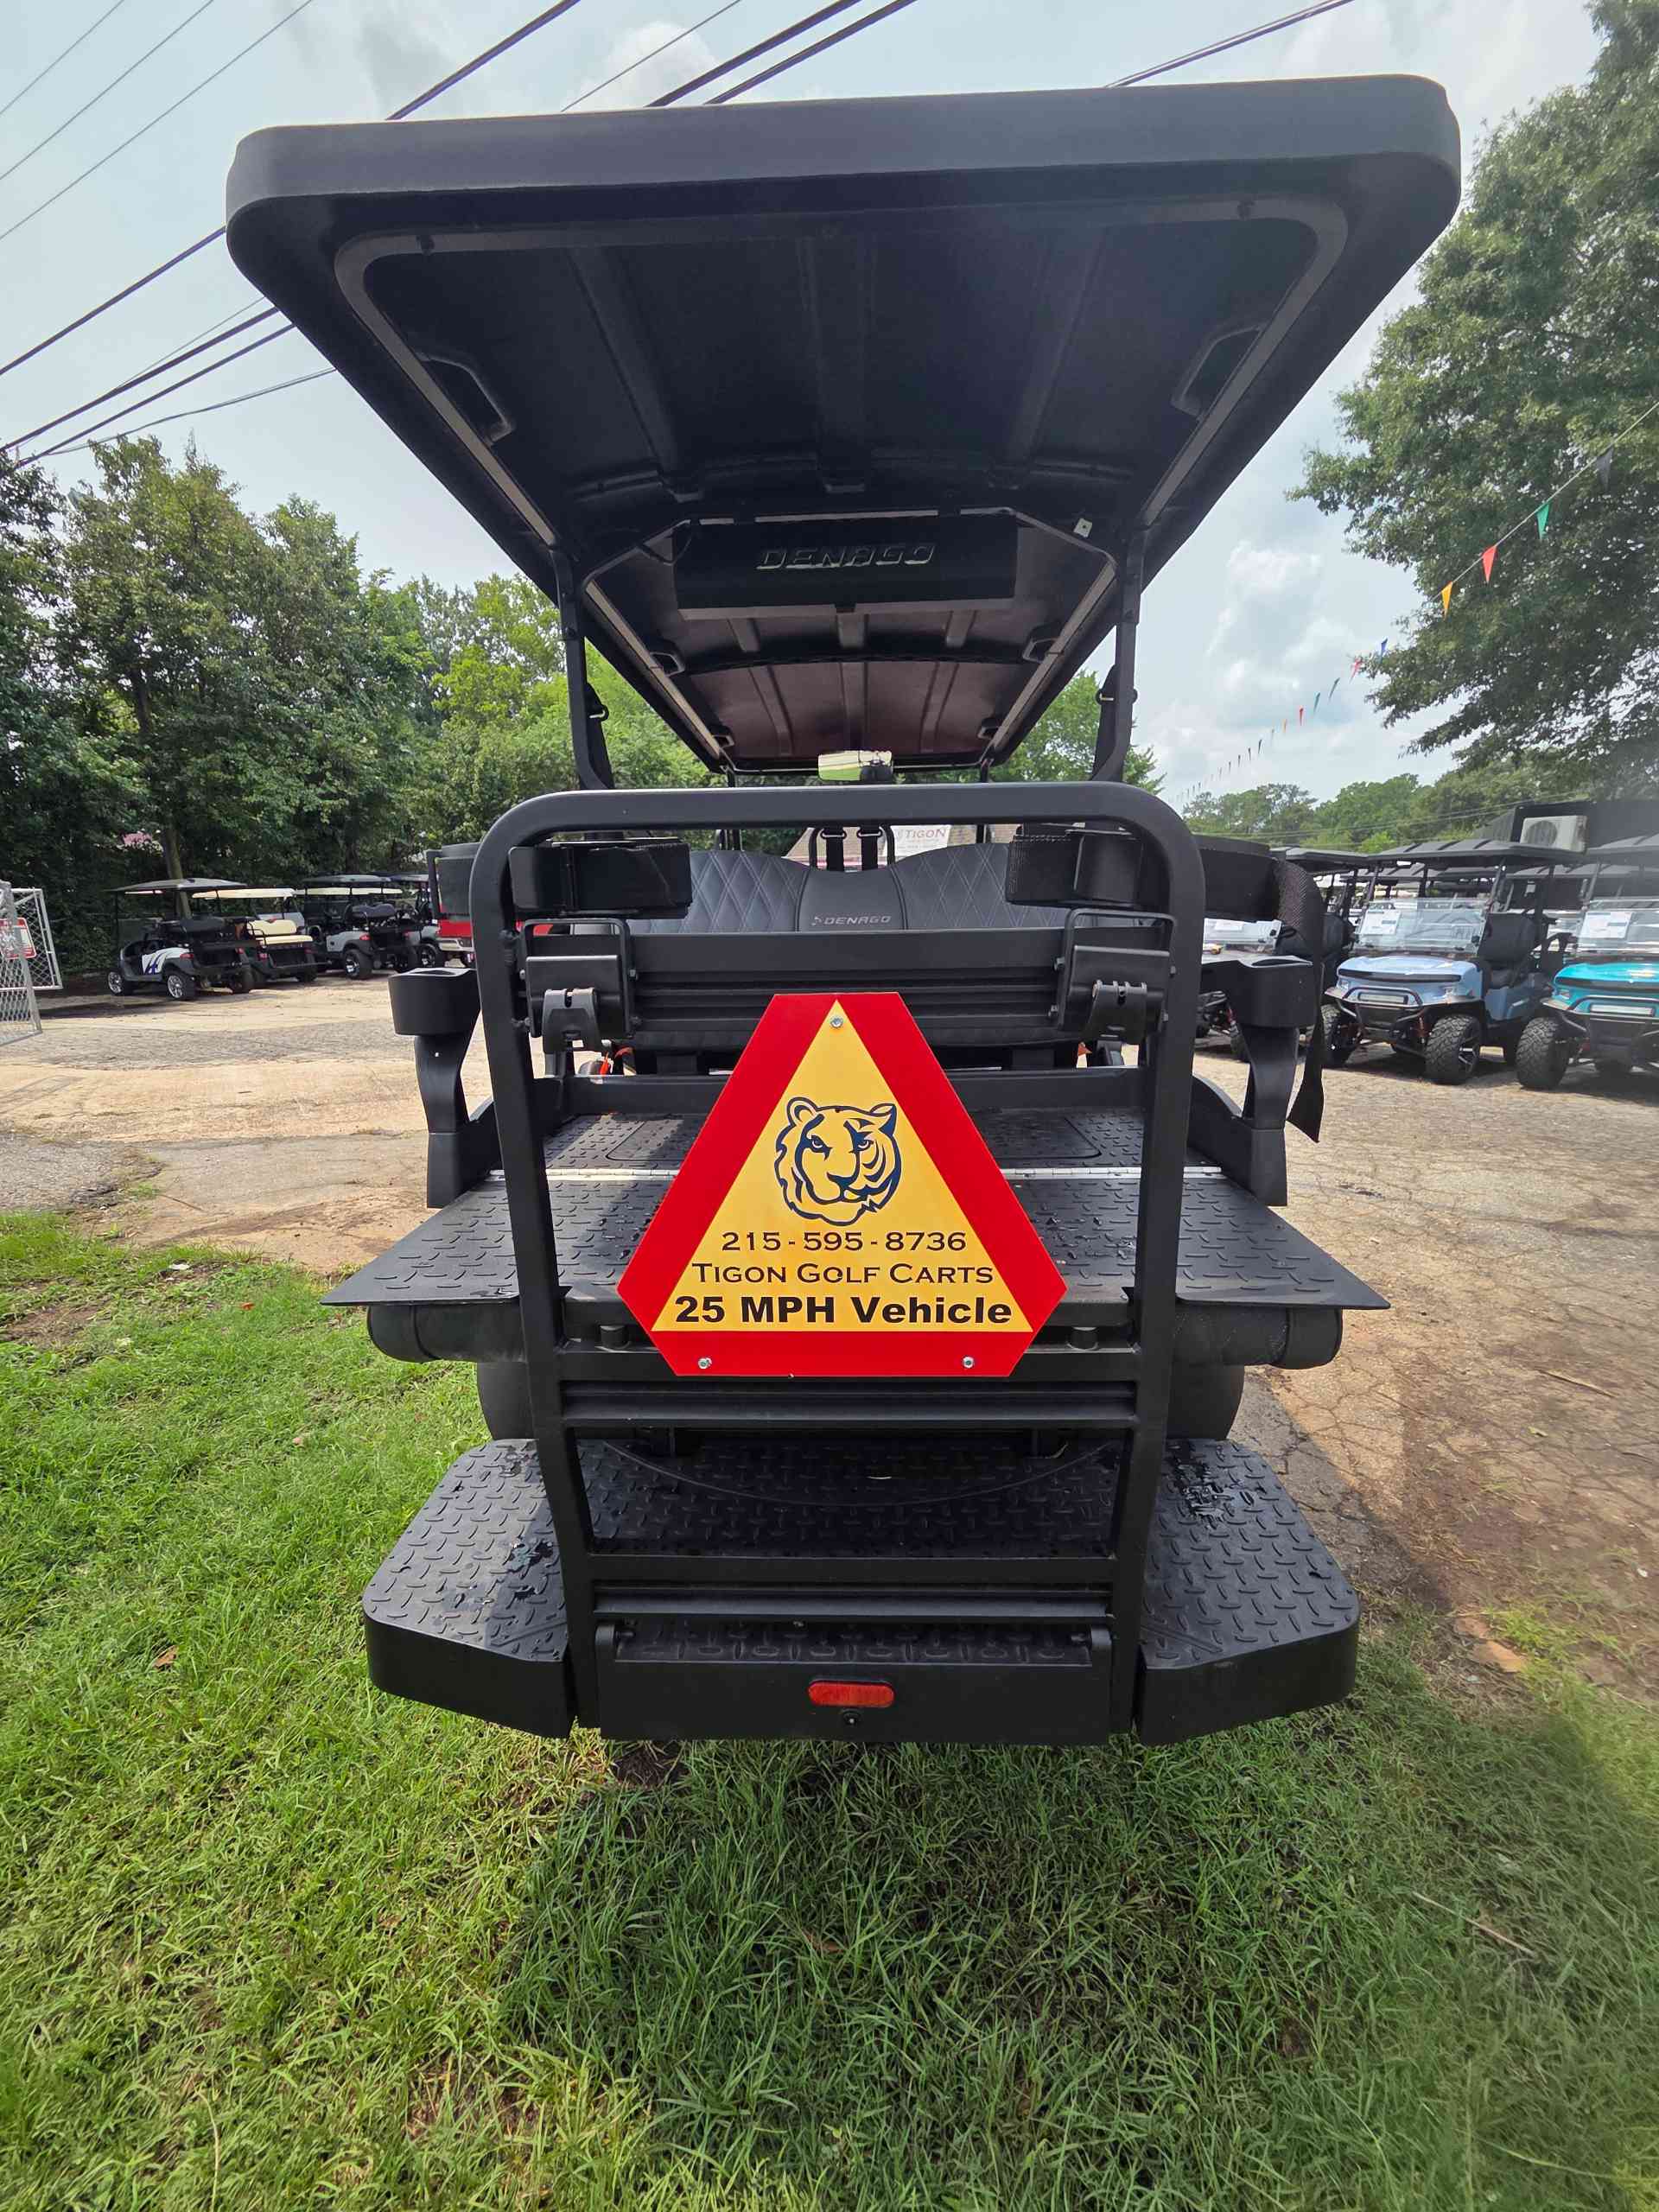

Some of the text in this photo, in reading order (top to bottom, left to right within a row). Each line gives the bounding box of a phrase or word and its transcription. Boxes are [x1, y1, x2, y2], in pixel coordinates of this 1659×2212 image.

[756, 544, 935, 569] DENAGO
[906, 829, 947, 839] TIGON
[823, 916, 892, 925] DENAGO
[675, 1295, 1012, 1324] 25 MPH Vehicle
